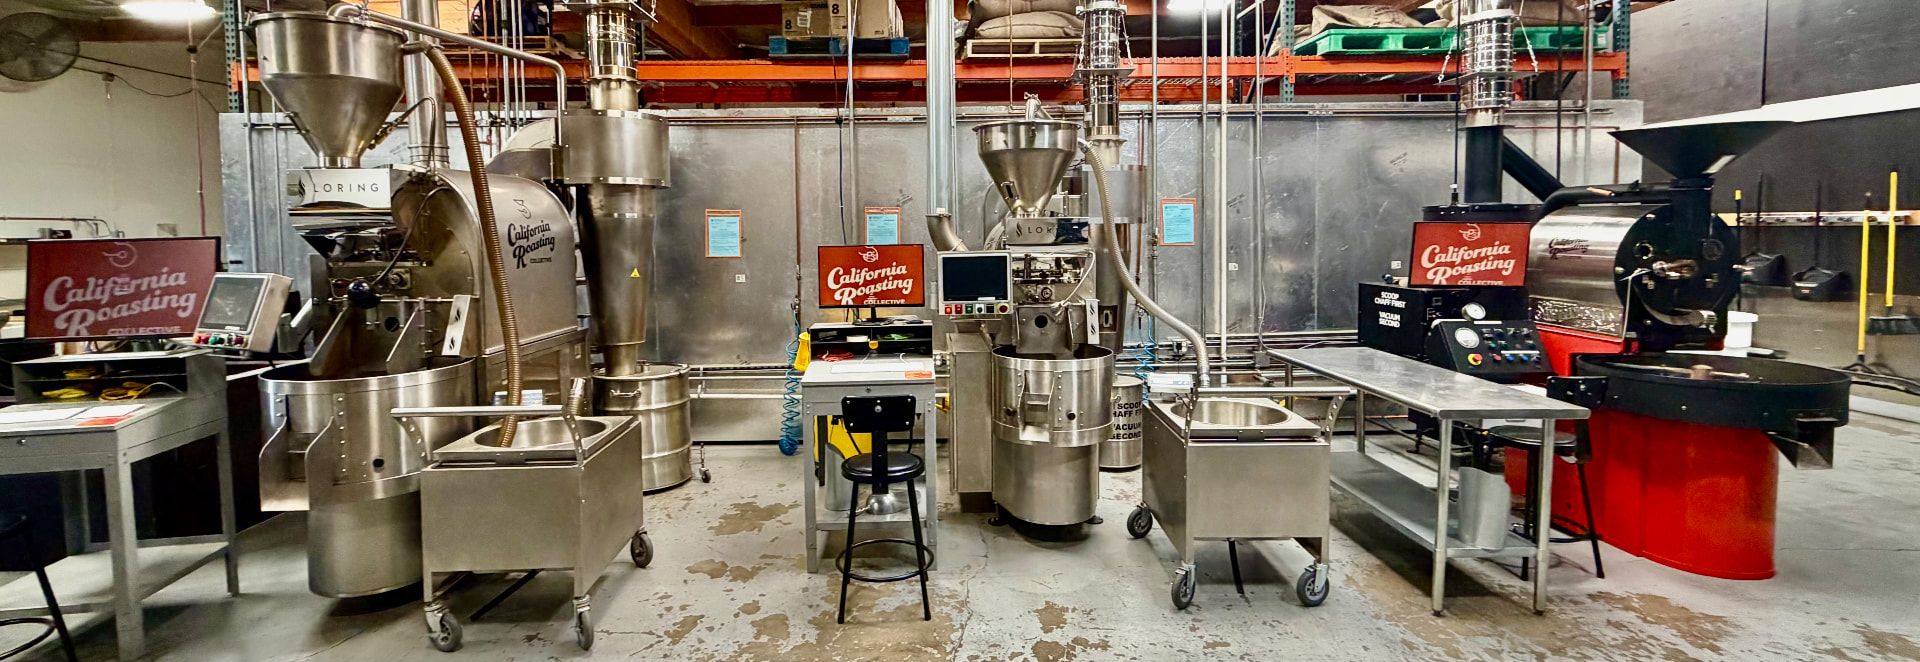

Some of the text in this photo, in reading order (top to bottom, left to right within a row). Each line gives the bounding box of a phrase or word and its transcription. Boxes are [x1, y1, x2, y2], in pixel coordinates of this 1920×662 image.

[831, 3, 840, 14] 8
[785, 19, 793, 30] 8
[313, 183, 379, 193] LORING
[507, 219, 551, 247] California
[512, 234, 555, 269] Roasting
[1420, 240, 1512, 268] California
[827, 261, 907, 290] California
[1426, 256, 1516, 285] Roasting
[43, 266, 188, 312] California
[833, 276, 914, 306] Roasting
[1374, 297, 1407, 309] CHAFF FIRST
[1380, 291, 1400, 300] SCOOP
[54, 290, 197, 337] Roasting
[1378, 310, 1401, 322] VACUUM
[1378, 318, 1401, 328] SECOND
